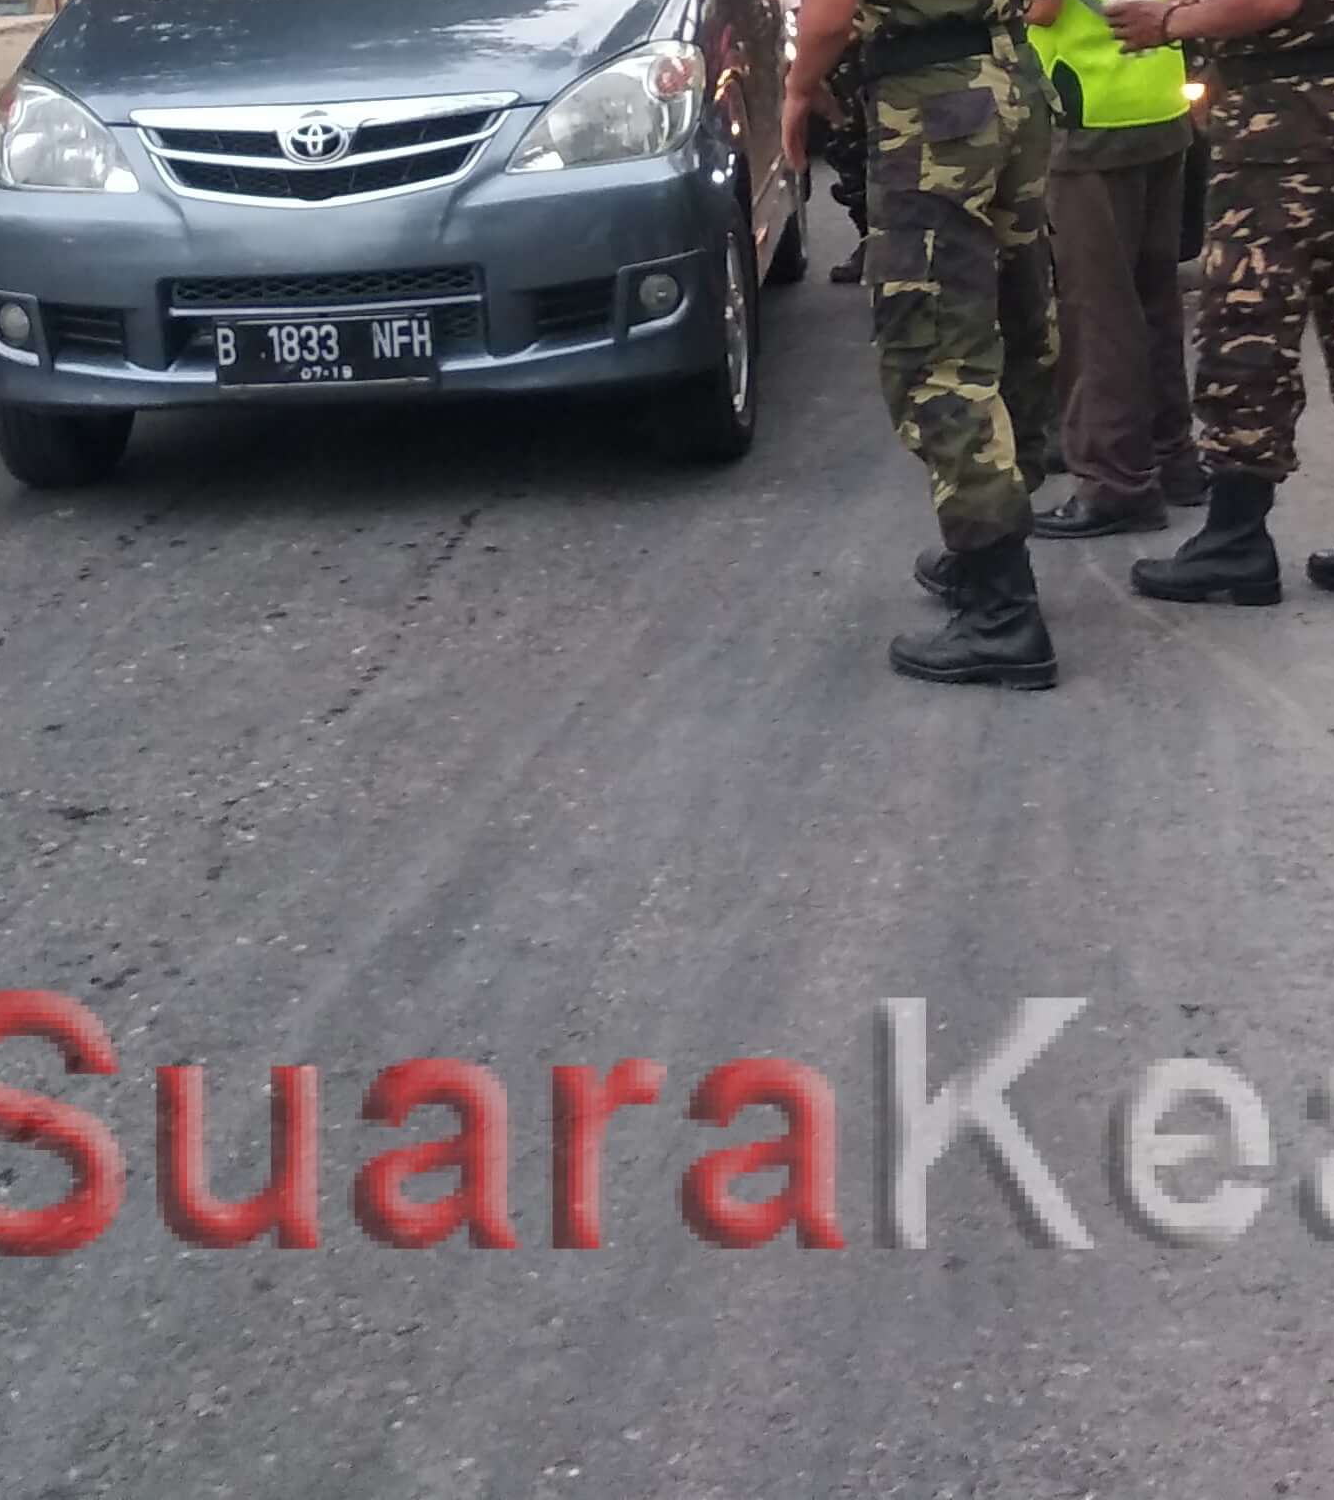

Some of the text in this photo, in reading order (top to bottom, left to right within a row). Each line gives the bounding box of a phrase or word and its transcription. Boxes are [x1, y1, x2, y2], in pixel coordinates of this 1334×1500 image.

[217, 319, 432, 366] B 1833 NFH
